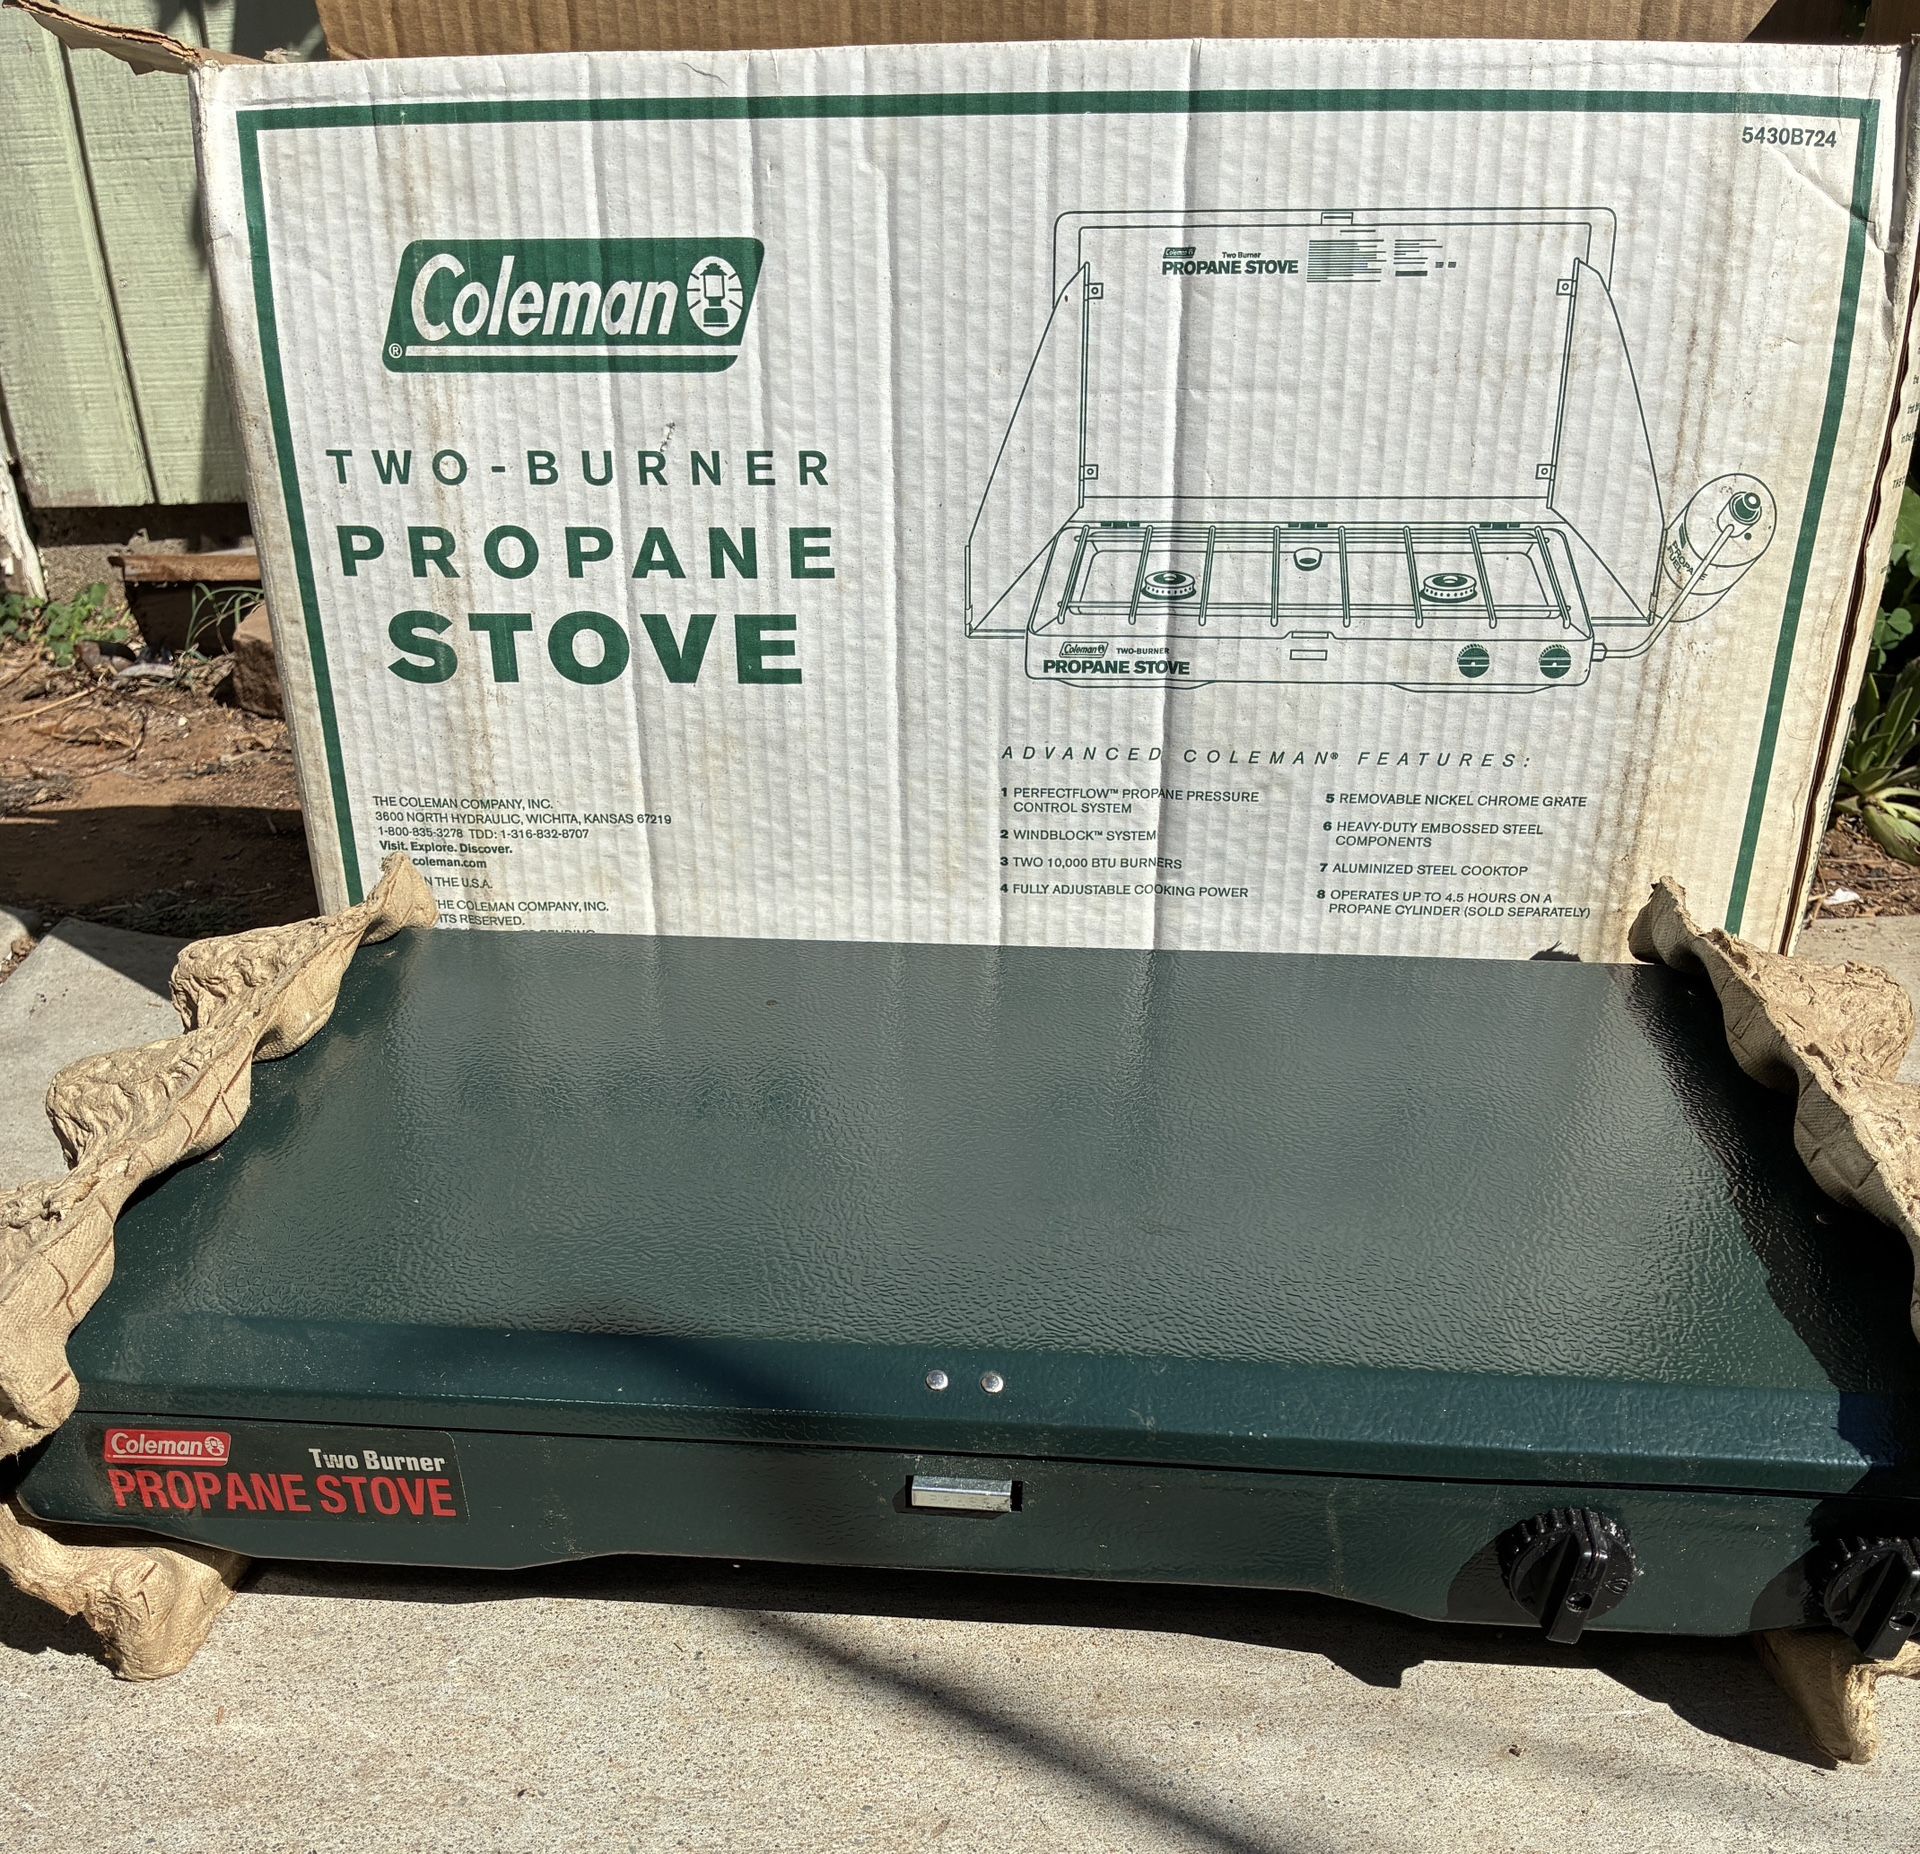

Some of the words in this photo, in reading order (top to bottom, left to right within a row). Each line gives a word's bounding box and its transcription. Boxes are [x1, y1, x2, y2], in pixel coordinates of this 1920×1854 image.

[1742, 127, 1837, 148] 5430B724
[1162, 261, 1241, 275] PROPANE
[1246, 260, 1298, 274] STOVE
[410, 253, 679, 342] Coleman
[326, 449, 829, 486] TWO-BURNER
[336, 524, 836, 580] PROPANE
[1672, 540, 1708, 580] PROPAE
[387, 609, 802, 686] STOVE
[1064, 644, 1096, 654] Coleman
[1043, 660, 1130, 673] PROPANE
[1134, 661, 1190, 675] STOVE
[1002, 746, 1161, 760] ADVANCED
[1358, 752, 1530, 768] FEATURES:
[1001, 788, 1007, 797] 1
[1122, 788, 1182, 800] PROPANE
[1187, 791, 1259, 802] PRESSURE
[1326, 794, 1334, 803] 5
[1340, 794, 1421, 805] REMOVABLE
[1424, 795, 1474, 806] NICKEL
[1478, 796, 1539, 807] CHROME
[1542, 797, 1587, 808] GRATE
[373, 796, 397, 807] THE
[399, 796, 458, 808] COLEMAN
[460, 798, 525, 810] COMPANY,
[528, 799, 554, 809] INC.
[1014, 802, 1077, 813] CONTROL
[1081, 803, 1132, 814] SYSTEM
[375, 811, 404, 821] 3600
[407, 812, 448, 823] NORTH
[451, 812, 524, 826] HYDRAULIC,
[526, 813, 581, 826] WICHITA,
[584, 814, 634, 824] KANSAS
[637, 814, 671, 825] 67219
[378, 826, 463, 838] 1-800-835-3278
[469, 829, 498, 839] TDD:
[501, 829, 589, 839] 1-316-832-8707
[1000, 830, 1008, 838] 2
[1106, 830, 1156, 841] SYSTEM
[1323, 822, 1332, 831] 6
[1337, 822, 1417, 832] HEAVY-DUTY
[1421, 823, 1498, 834] EMBOSSED
[1502, 824, 1544, 835] STEEL
[379, 841, 408, 851] Visit.
[411, 842, 457, 854] Explore.
[460, 843, 513, 854] Discover.
[1336, 836, 1432, 848] COMPONENTS
[412, 856, 487, 868] coleman.com
[1000, 856, 1008, 866] 3
[1014, 857, 1042, 867] TWO
[1048, 858, 1088, 869] 10,000
[1092, 858, 1116, 868] BTU
[1120, 858, 1182, 869] BURNERS
[1319, 864, 1328, 872] 7
[1332, 863, 1412, 874] ALUMINIZED
[1416, 864, 1457, 875] STEEL
[1461, 865, 1528, 876] COOKTOP
[435, 877, 459, 888] THE
[461, 877, 493, 889] U.S.A.
[1000, 884, 1008, 893] 4
[1014, 884, 1048, 894] FULLY
[1052, 884, 1131, 895] ADJUSTABLE
[1134, 884, 1195, 896] COOKING
[1199, 886, 1248, 898] POWER
[1316, 890, 1325, 899] 8
[1331, 890, 1398, 901] OPERATES
[1402, 891, 1421, 901] UP
[1424, 892, 1442, 902] TO
[1445, 892, 1464, 902] 4.5
[1468, 892, 1516, 903] HOURS
[1520, 894, 1540, 904] ON
[1543, 894, 1552, 904] A
[437, 900, 454, 909] HE
[457, 900, 515, 911] COLEMAN
[518, 902, 582, 912] COMPANY,
[584, 902, 609, 911] INC.
[1329, 904, 1391, 915] PROPANE
[1395, 905, 1460, 916] CYLINDER
[1464, 906, 1504, 918] (SOLD
[1507, 906, 1590, 919] SEPARATELY)
[460, 915, 525, 926] RESERVED.
[111, 1433, 202, 1456] Coleman
[308, 1448, 358, 1470] Two
[365, 1452, 445, 1472] Burner
[107, 1469, 312, 1512] PROPANE
[319, 1475, 457, 1518] STOVE
